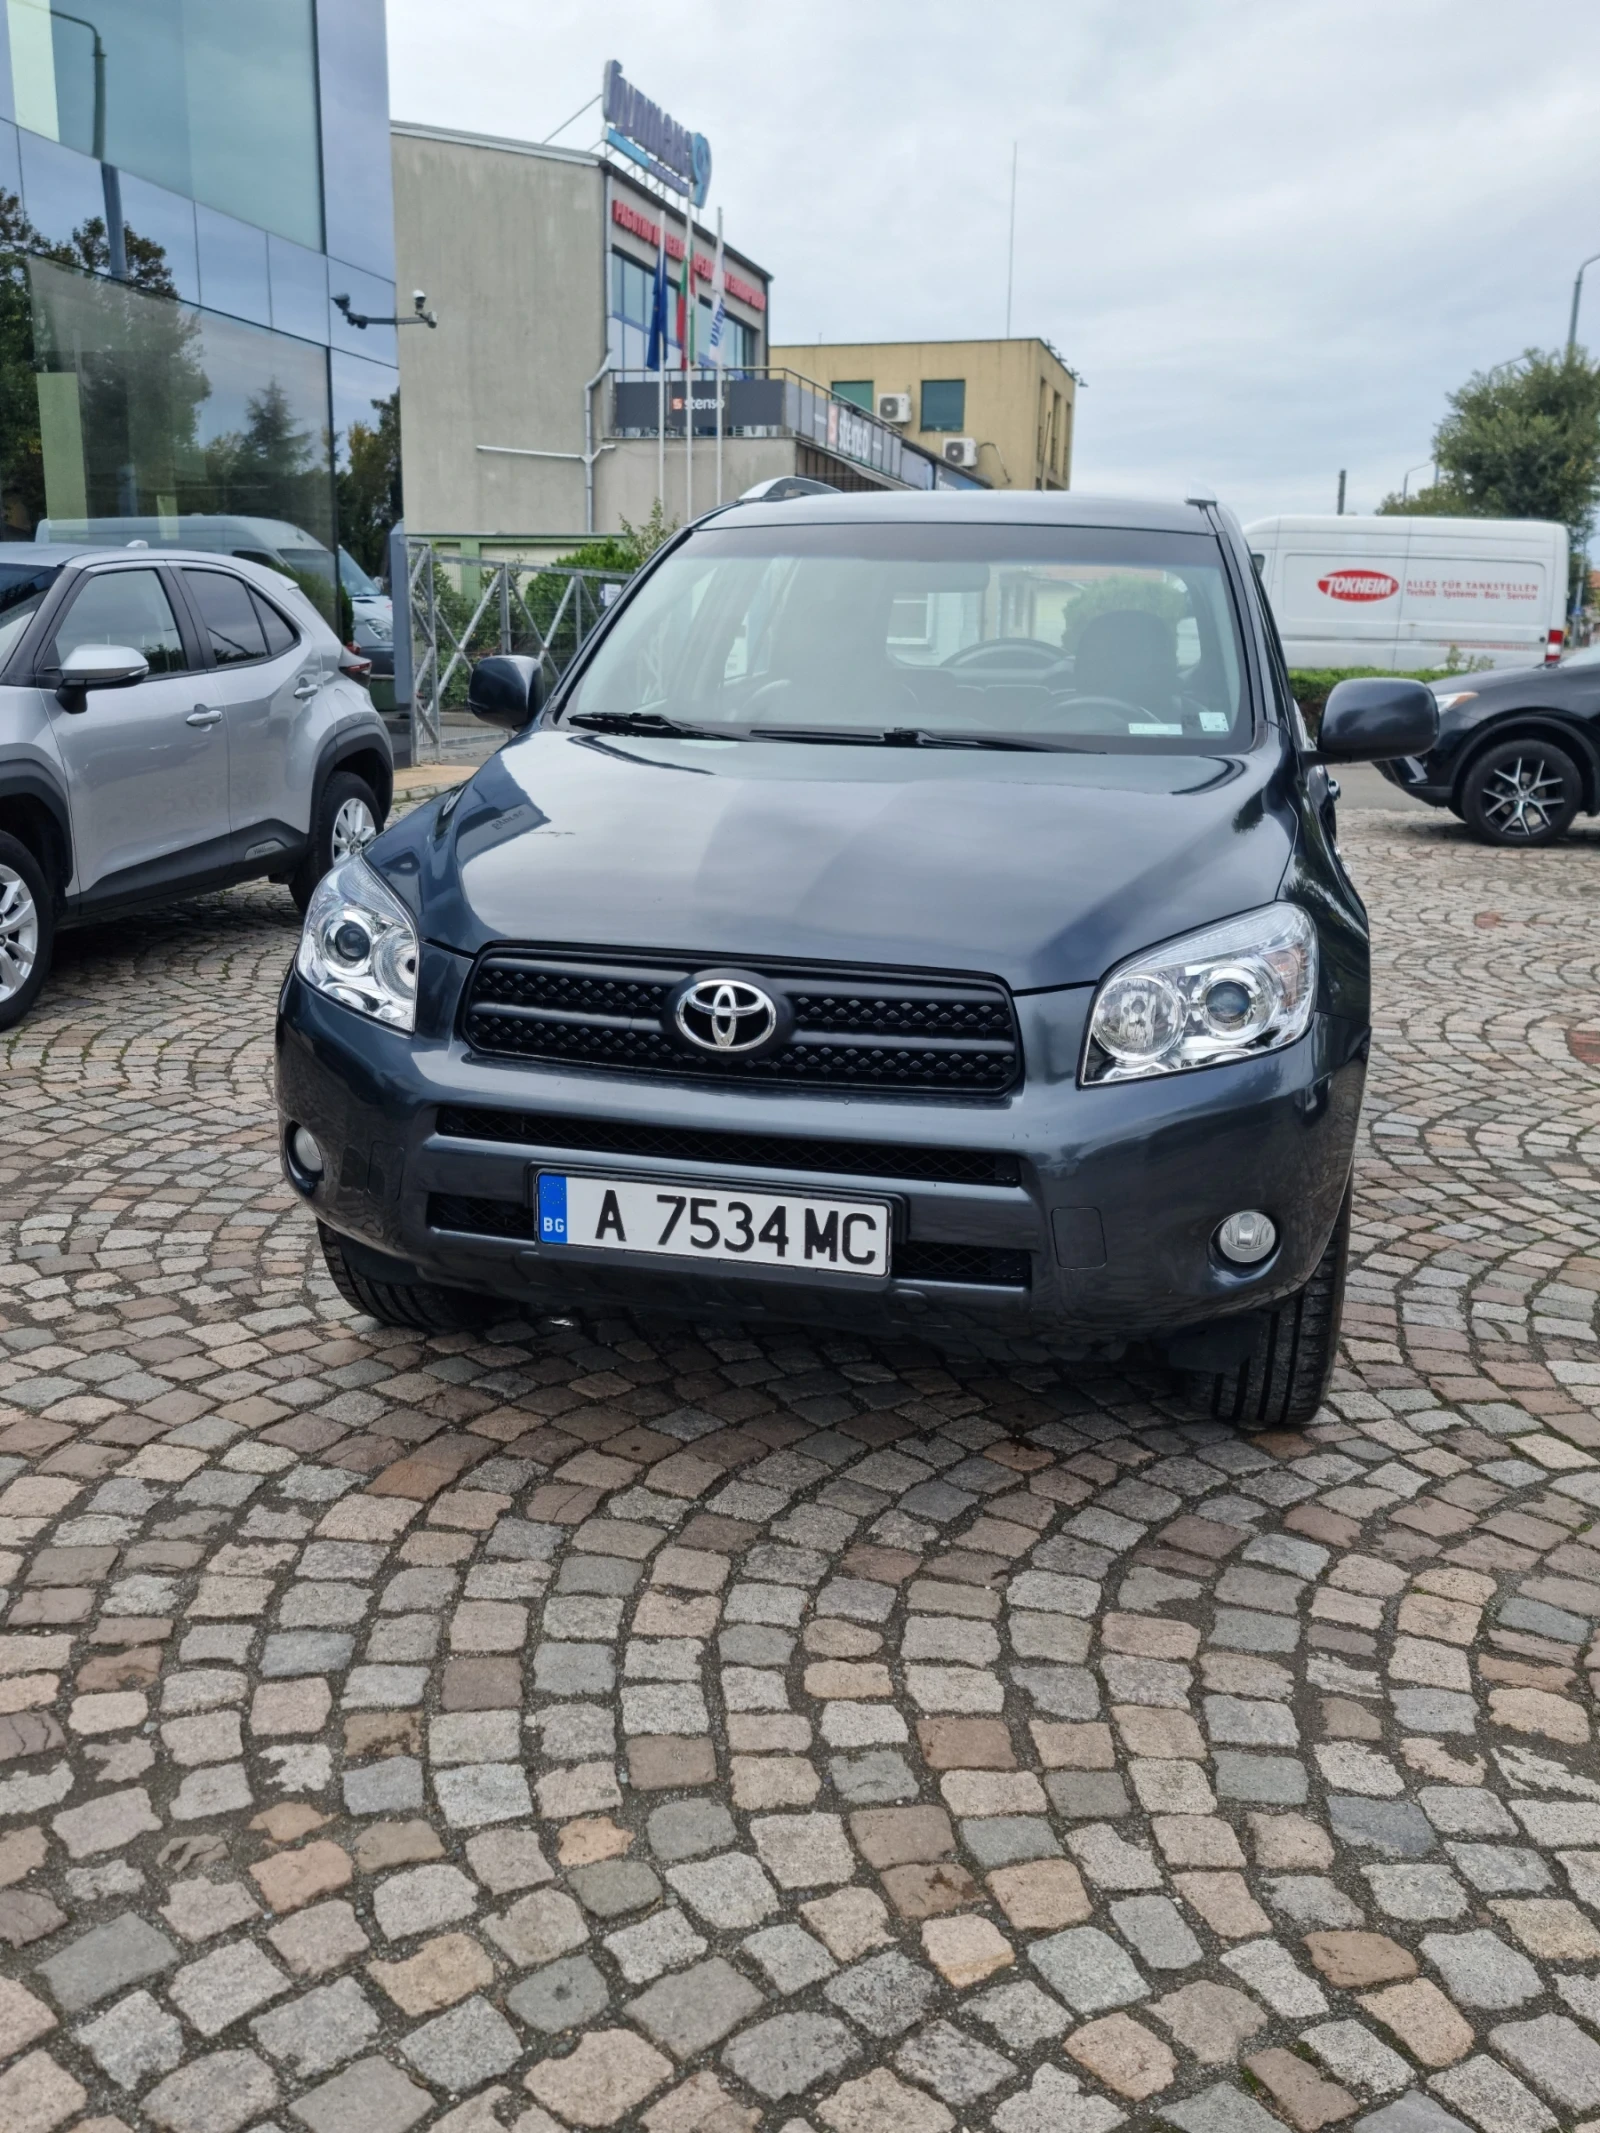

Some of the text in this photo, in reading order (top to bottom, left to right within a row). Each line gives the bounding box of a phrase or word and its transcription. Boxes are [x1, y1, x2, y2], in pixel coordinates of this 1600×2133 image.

[1317, 576, 1392, 596] TOKHEIM
[1407, 580, 1437, 589] ALLES
[1466, 581, 1538, 592] TANKSTELLEN
[1443, 589, 1477, 599] Systeme
[1507, 591, 1537, 600] Service
[543, 1217, 565, 1233] BG
[595, 1189, 876, 1265] A 7534 MC
